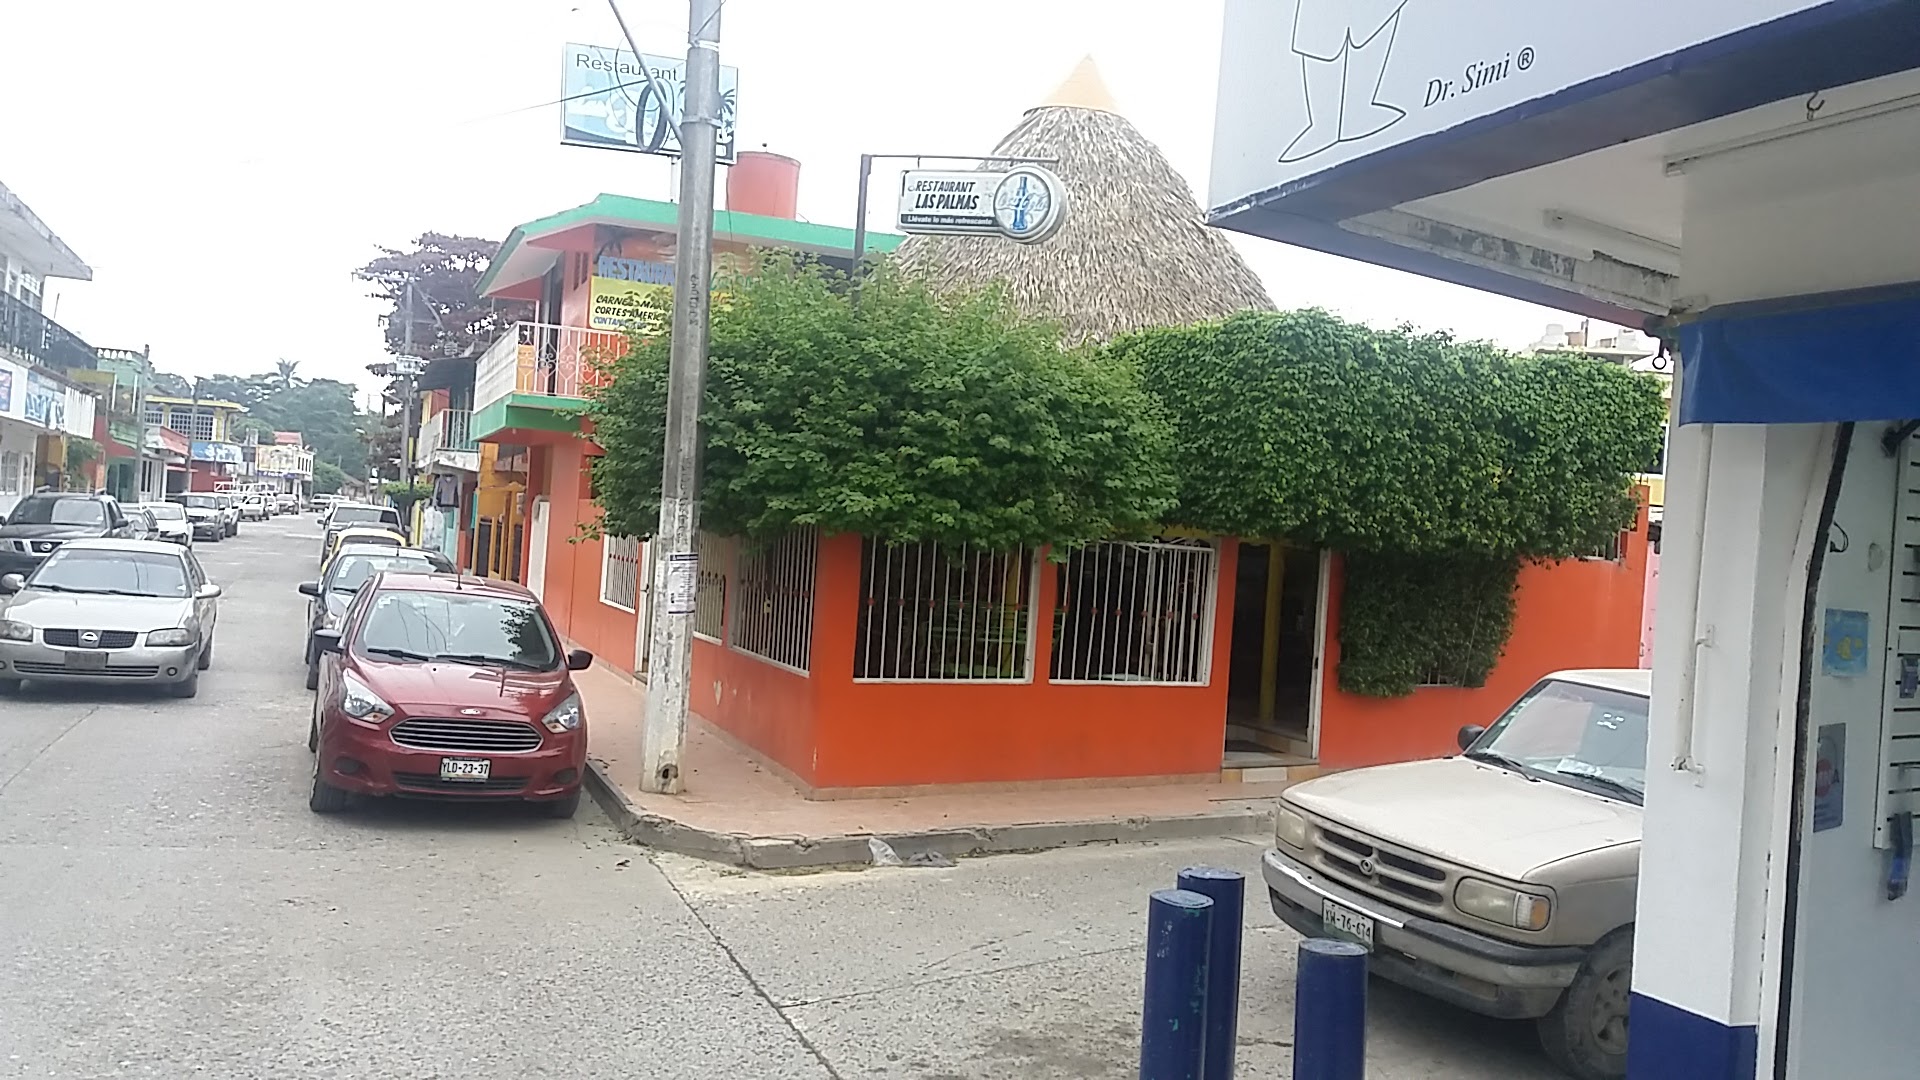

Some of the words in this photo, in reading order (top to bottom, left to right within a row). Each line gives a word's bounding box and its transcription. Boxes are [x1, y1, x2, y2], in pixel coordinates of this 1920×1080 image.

[576, 53, 677, 81] Restauant
[1423, 79, 1455, 108] Dr.
[1461, 52, 1510, 94] Simi
[915, 180, 976, 193] RESTAURANT
[915, 193, 936, 209] LAS
[936, 194, 980, 210] PALMAS
[595, 305, 627, 317] CORTES
[442, 762, 489, 775] YLD-23-37
